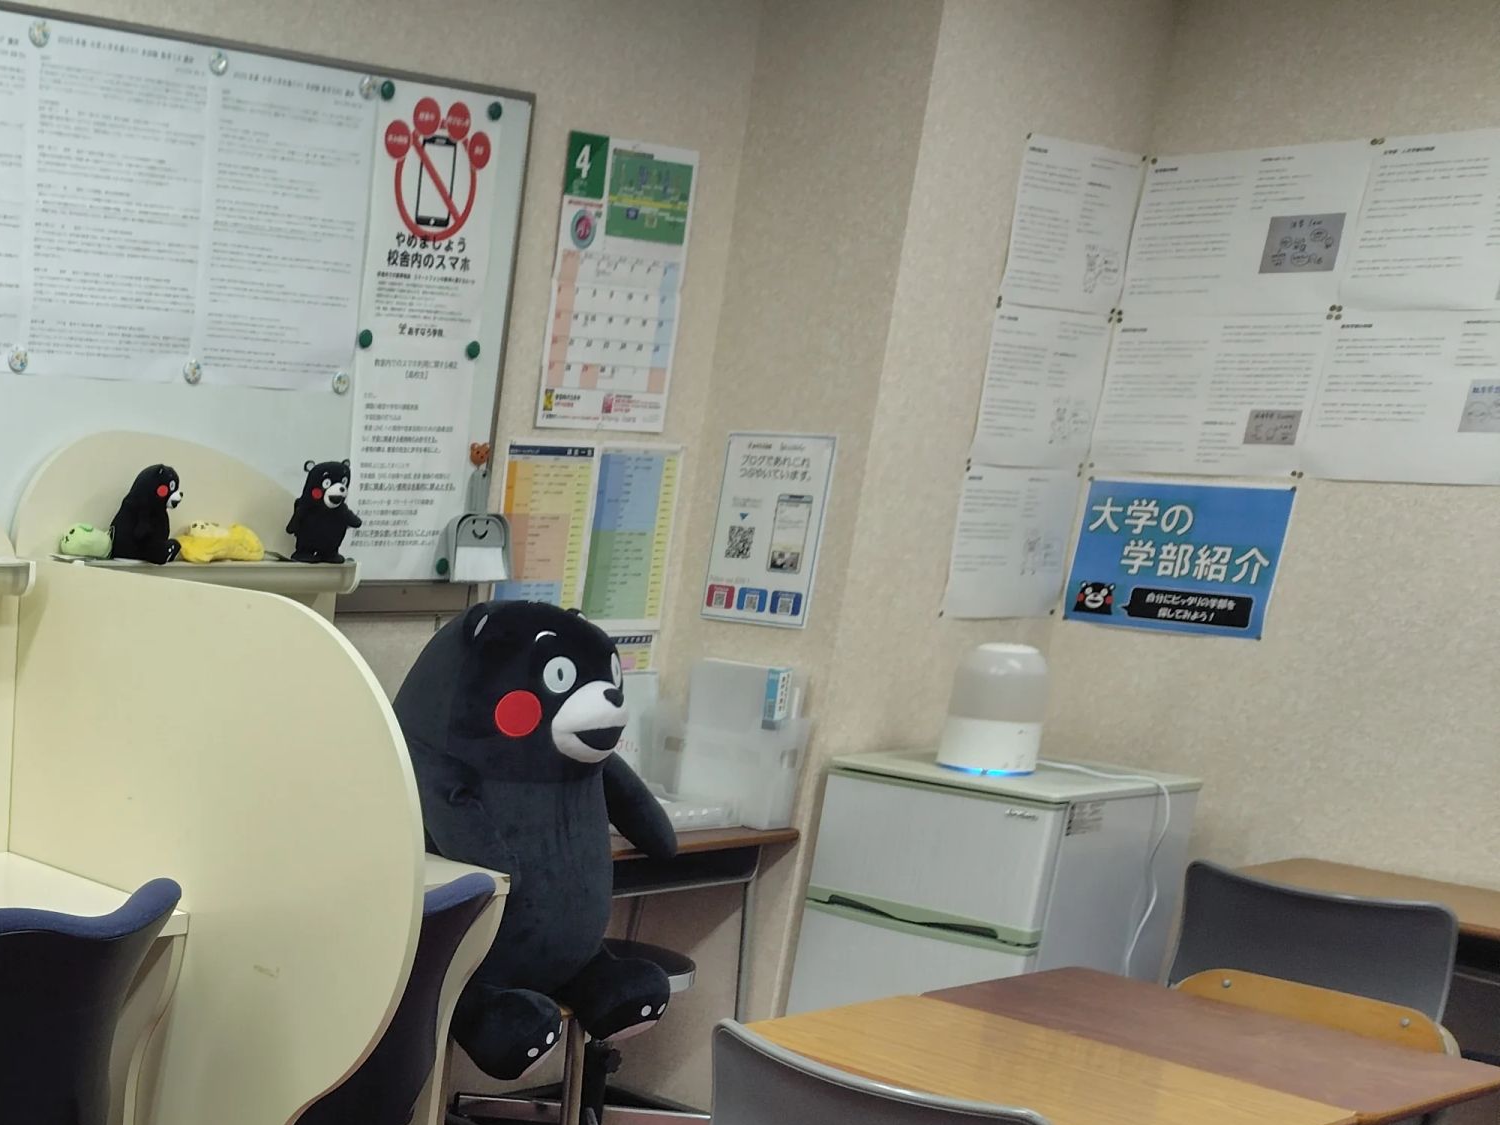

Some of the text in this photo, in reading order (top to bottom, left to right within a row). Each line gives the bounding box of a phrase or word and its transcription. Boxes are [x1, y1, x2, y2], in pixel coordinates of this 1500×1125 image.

[575, 144, 592, 179] 4
[396, 232, 466, 253] やめましょう
[387, 249, 470, 272] 校舎内のスマホ
[1088, 497, 1194, 536] 大学の
[1120, 539, 1270, 585] 学部紹介
